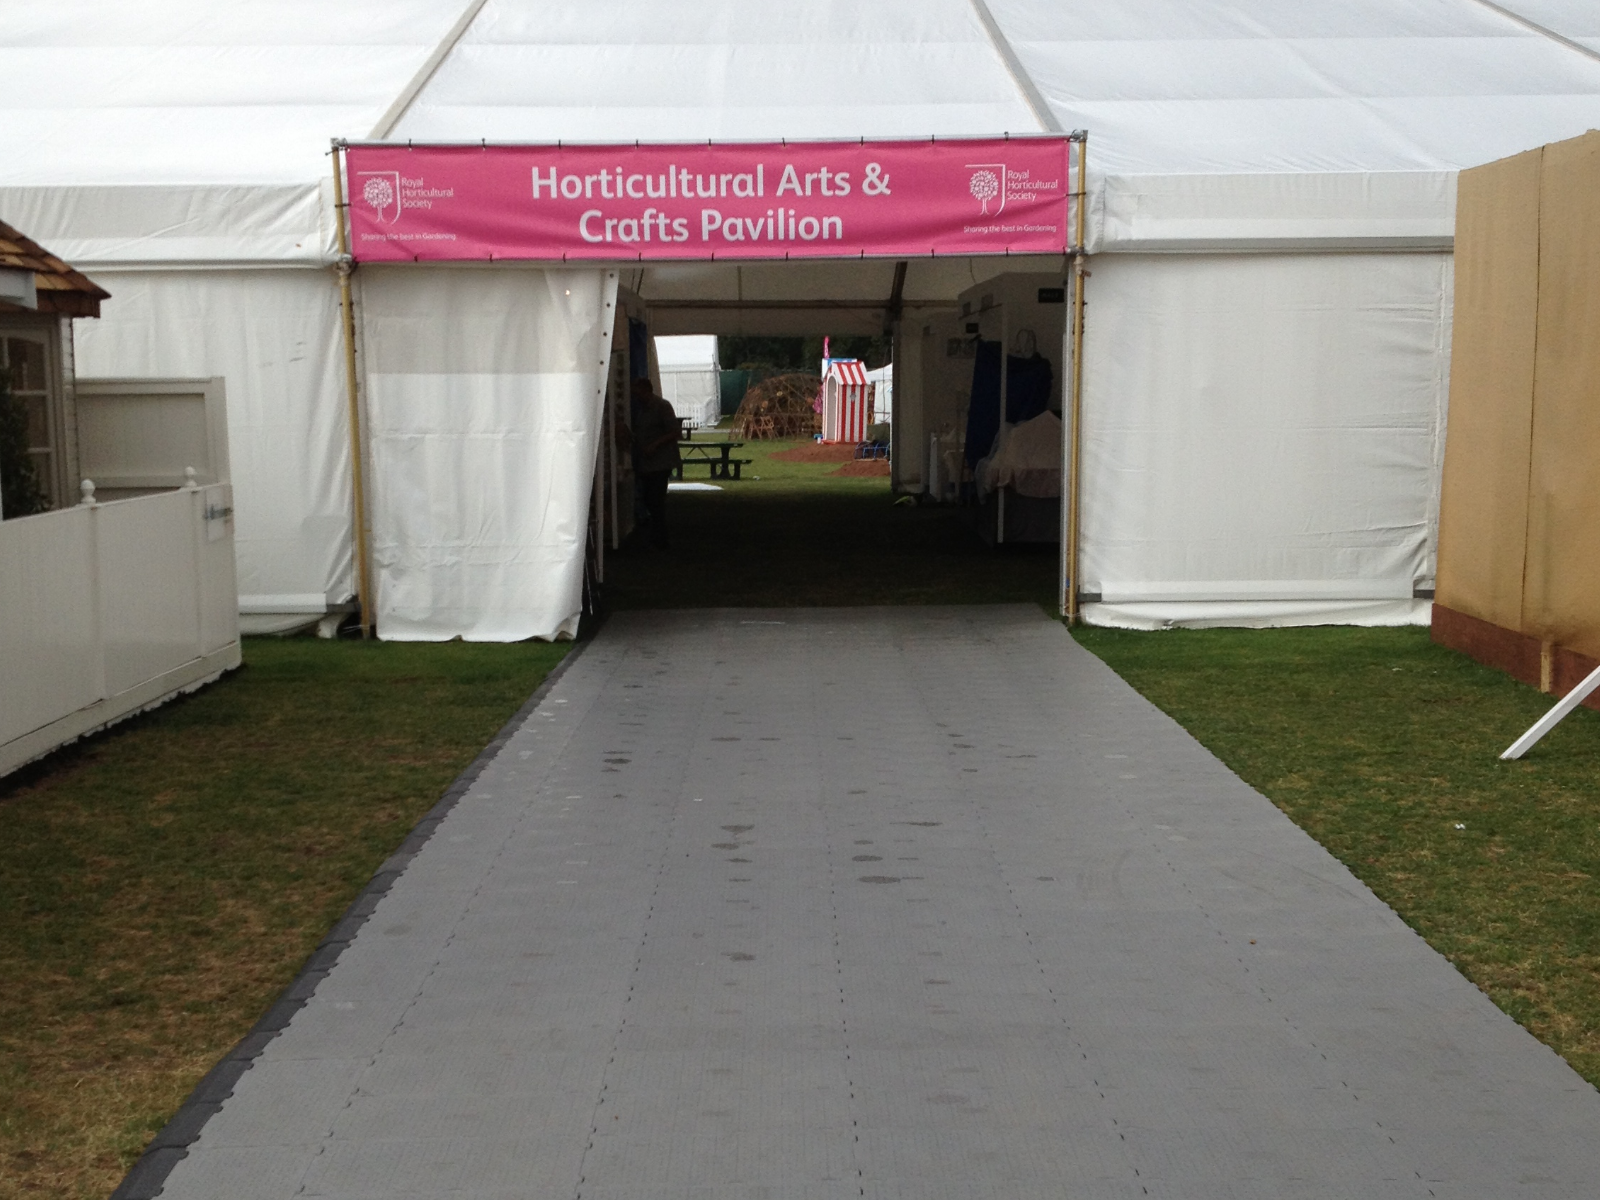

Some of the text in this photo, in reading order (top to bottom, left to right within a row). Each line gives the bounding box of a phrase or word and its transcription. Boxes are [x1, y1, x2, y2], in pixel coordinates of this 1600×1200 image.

[1007, 169, 1030, 181] Royal
[401, 177, 424, 189] Royal
[531, 162, 892, 200] Horticultural Arts &
[1007, 179, 1059, 190] Horticultural
[402, 187, 455, 198] Horticultural
[1007, 191, 1037, 202] Society
[402, 199, 433, 210] Society
[579, 207, 843, 243] Crafts Pavilion
[963, 225, 988, 235] Sharing
[1001, 224, 1015, 232] best
[1023, 223, 1057, 233] Gardening
[361, 232, 387, 242] Sharing
[387, 232, 399, 241] the
[399, 232, 414, 241] best
[422, 232, 457, 241] Gardening
